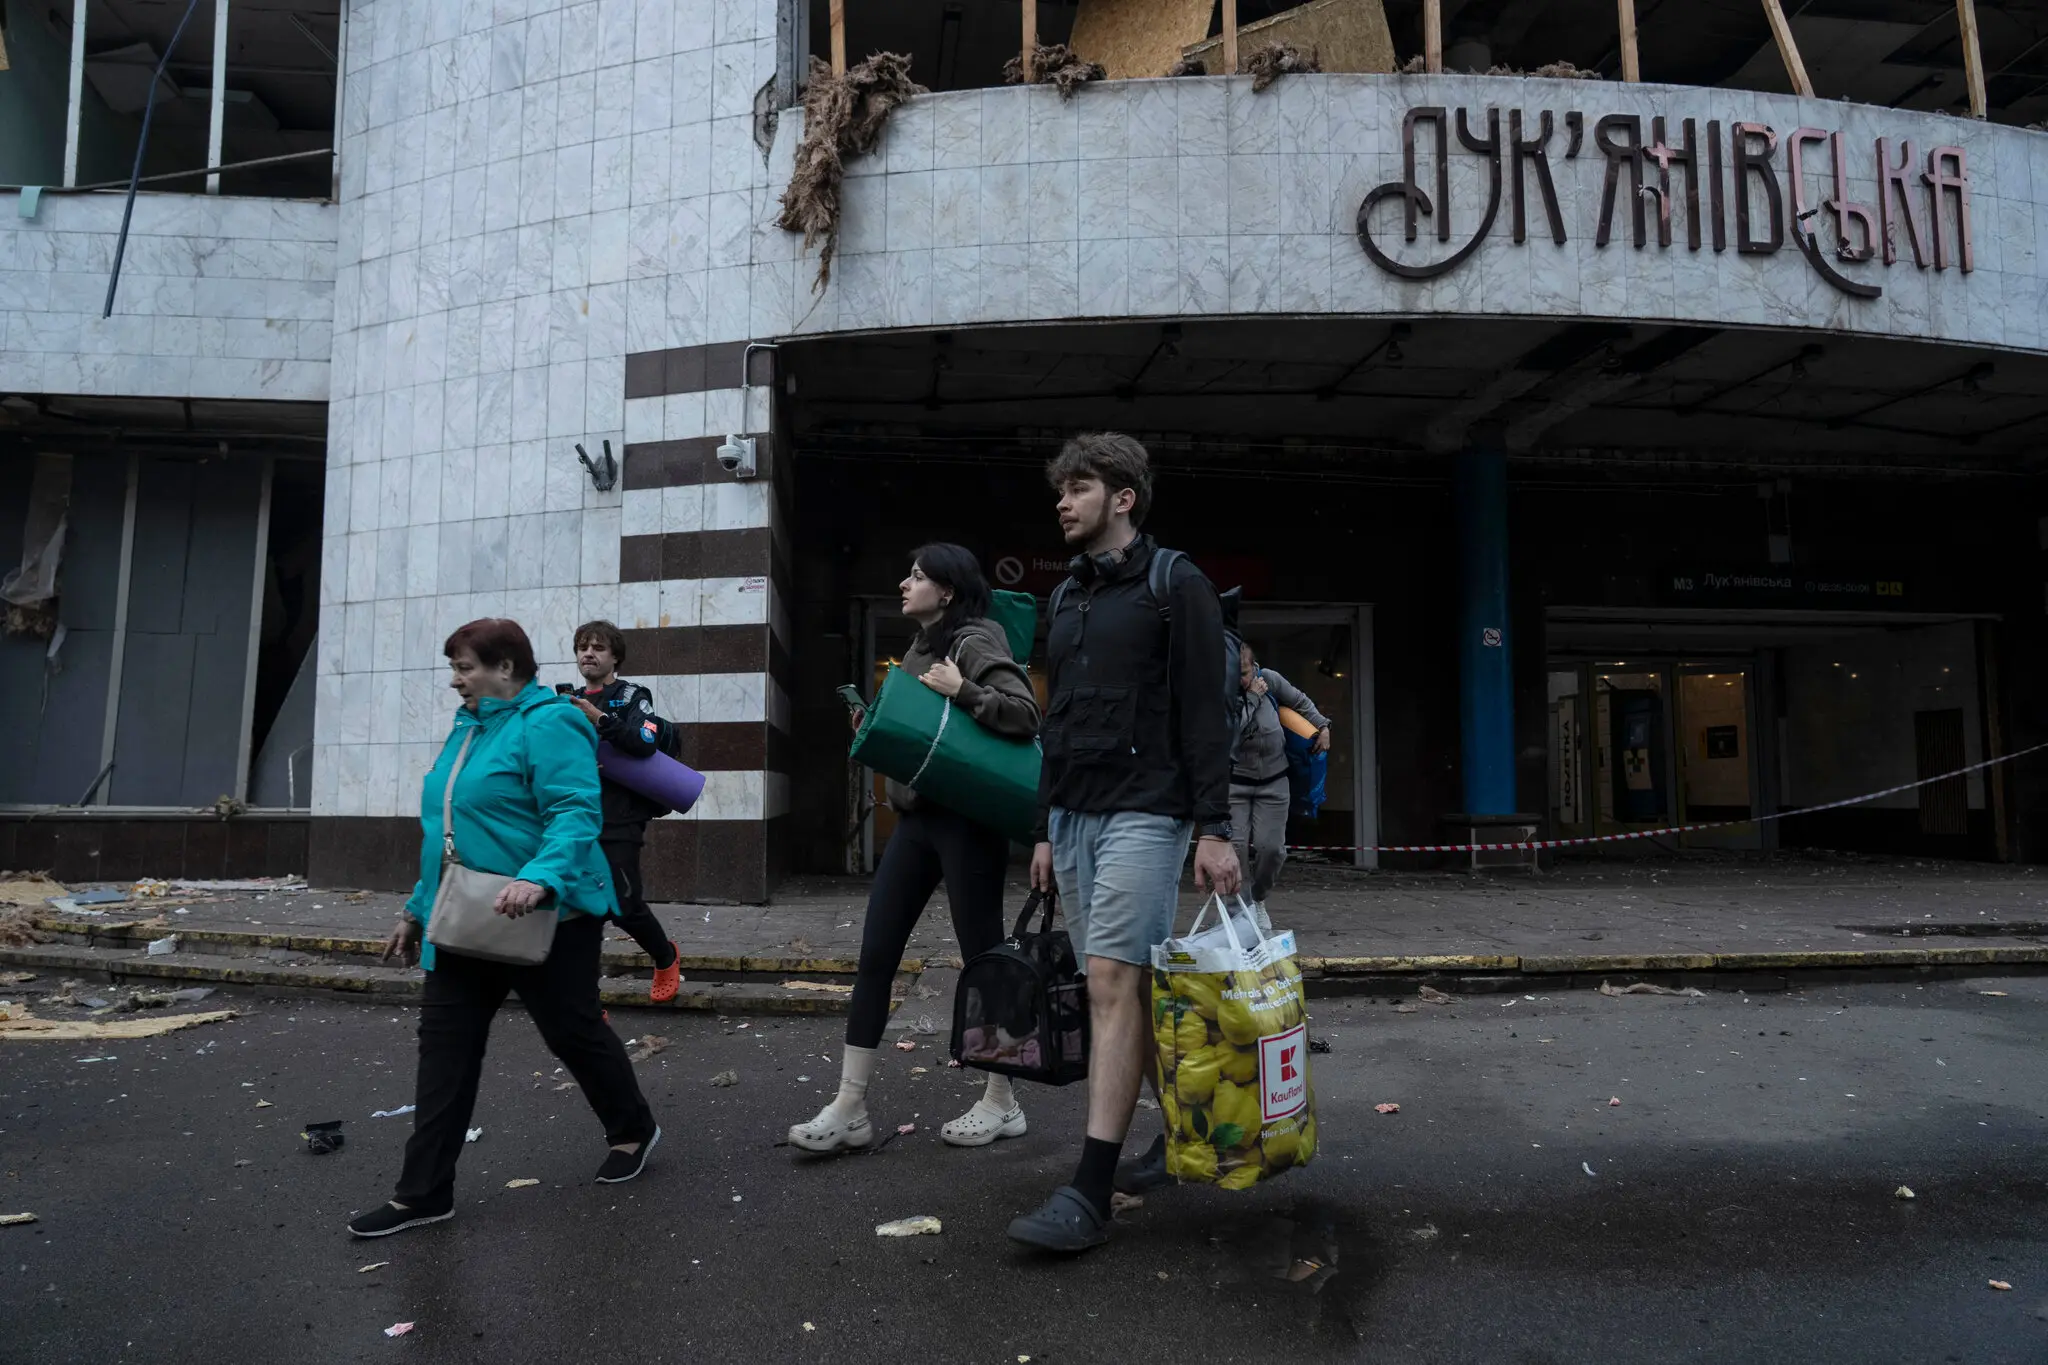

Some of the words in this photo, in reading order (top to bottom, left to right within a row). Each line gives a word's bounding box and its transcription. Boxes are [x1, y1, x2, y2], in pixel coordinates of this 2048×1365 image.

[1356, 106, 1974, 299] ЛУК'ЯНІВСЬКА
[1033, 558, 1070, 571] Нема
[1703, 573, 1793, 588] Лук'янівська
[1264, 985, 1276, 997] 10
[1271, 1083, 1303, 1104] Kaufland
[1261, 1130, 1276, 1139] Hier
